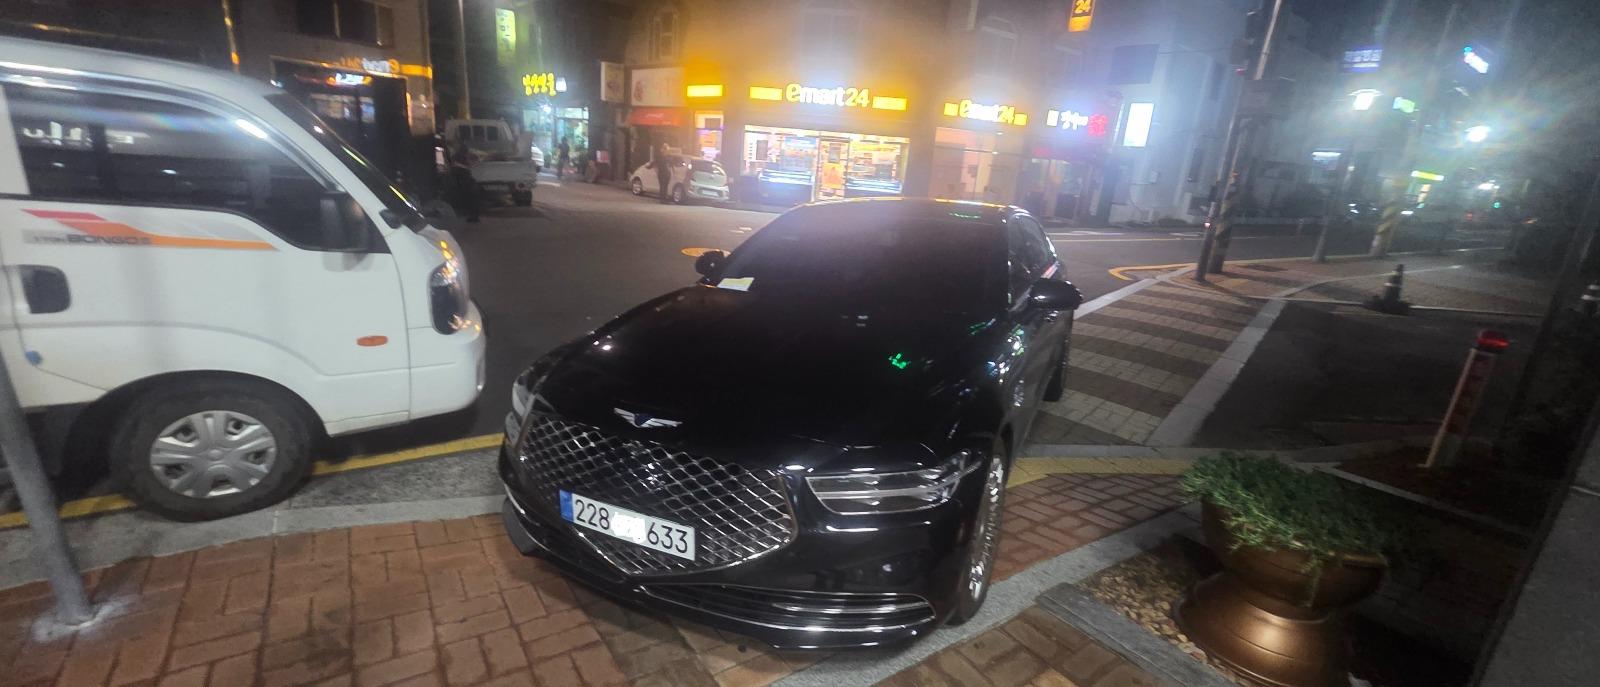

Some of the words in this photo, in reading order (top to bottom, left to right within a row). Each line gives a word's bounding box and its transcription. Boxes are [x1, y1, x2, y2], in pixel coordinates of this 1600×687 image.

[786, 83, 869, 107] emart24
[575, 499, 610, 530] 228
[647, 522, 688, 553] 633
